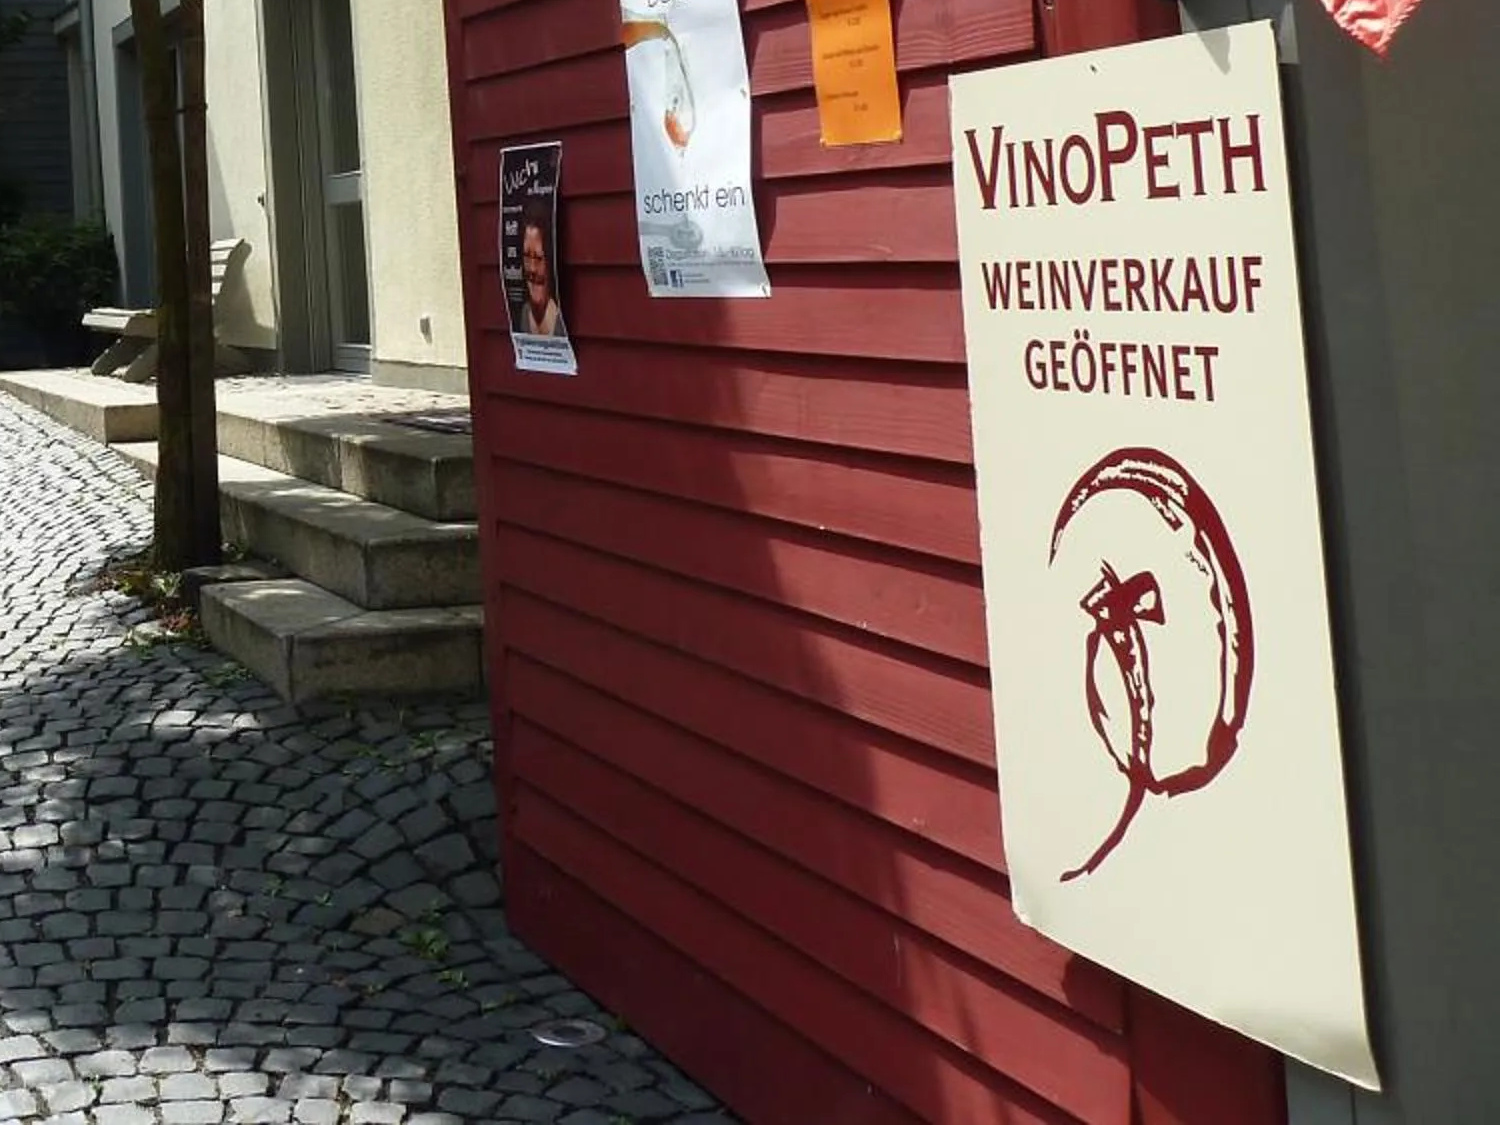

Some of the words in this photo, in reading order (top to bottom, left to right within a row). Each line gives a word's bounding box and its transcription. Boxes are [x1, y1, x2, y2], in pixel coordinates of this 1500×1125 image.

[644, 185, 709, 214] schenkt
[716, 181, 746, 208] ein
[981, 256, 1263, 314] WEINVERKAUF
[1024, 328, 1220, 402] GEÖFFNET
